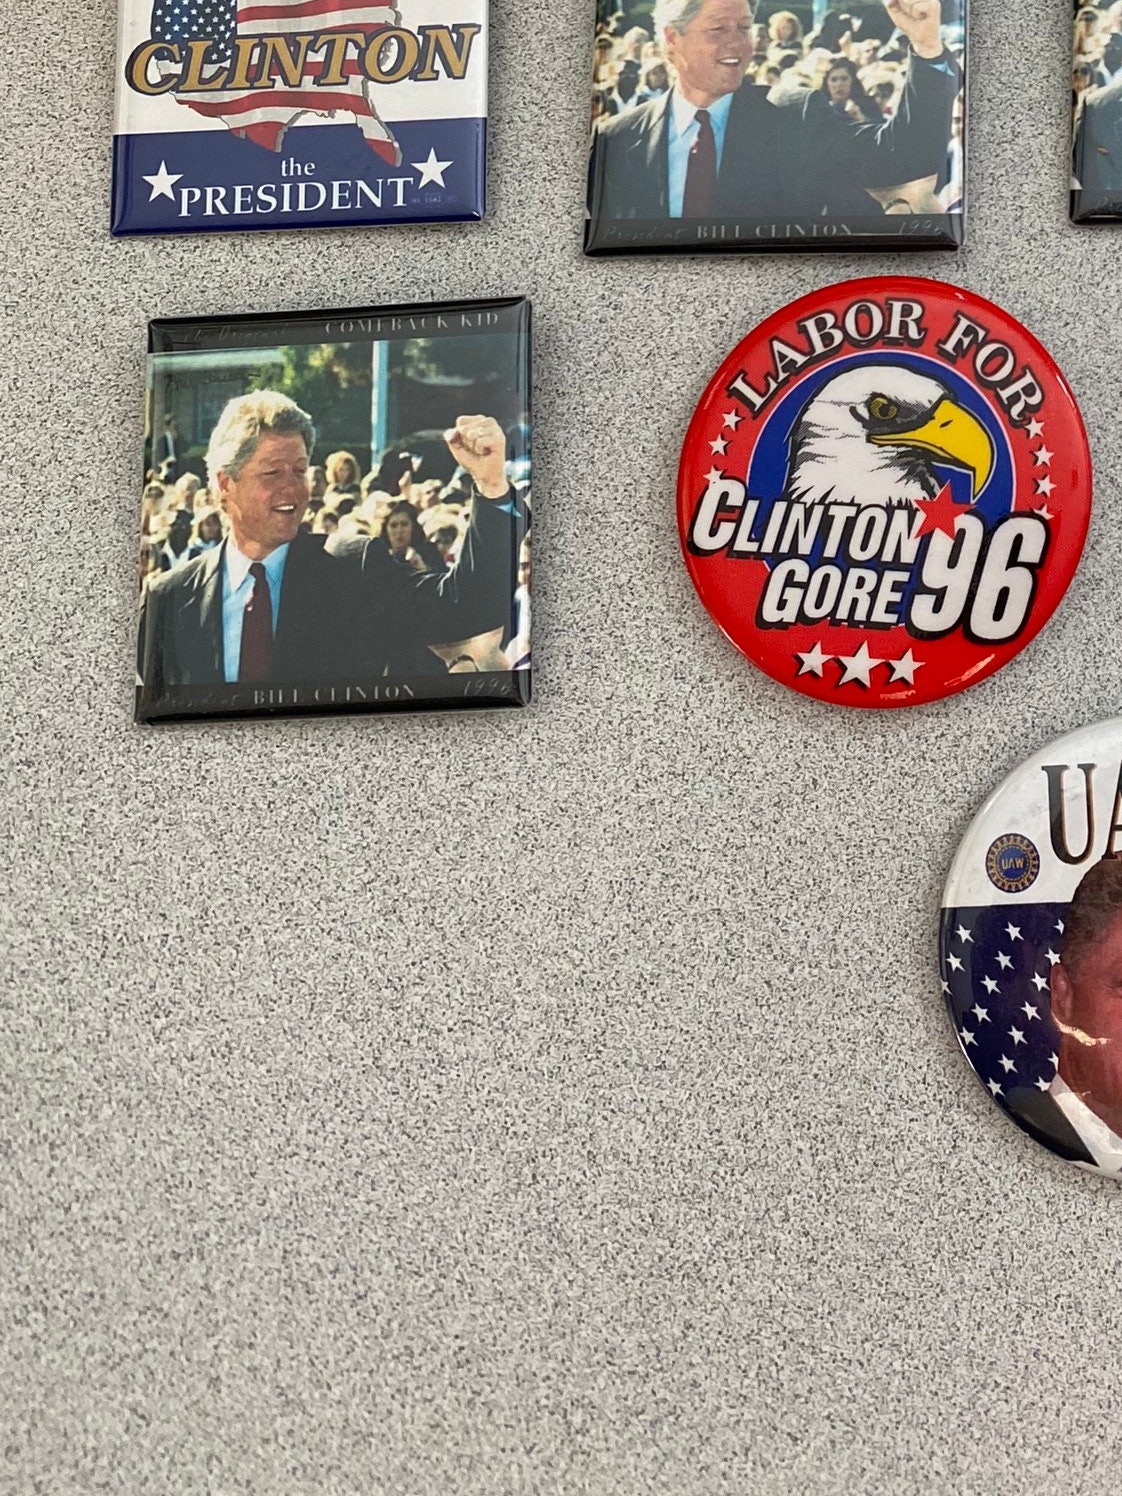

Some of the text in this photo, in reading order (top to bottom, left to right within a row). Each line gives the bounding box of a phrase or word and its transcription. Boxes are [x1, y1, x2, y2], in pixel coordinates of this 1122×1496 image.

[125, 22, 482, 97] CLINTON
[280, 157, 316, 177] the
[178, 176, 415, 217] PRESIDENT
[696, 223, 745, 239] BILL
[755, 223, 853, 238] CLINTON
[324, 312, 499, 335] COMEBACK KID
[730, 300, 1045, 422] LABOR FOR
[691, 478, 924, 565] CLINTON
[761, 512, 1049, 641] GORE 96
[253, 688, 301, 705] BILL
[313, 683, 416, 703] CLINTON
[1001, 857, 1025, 870] UAW
